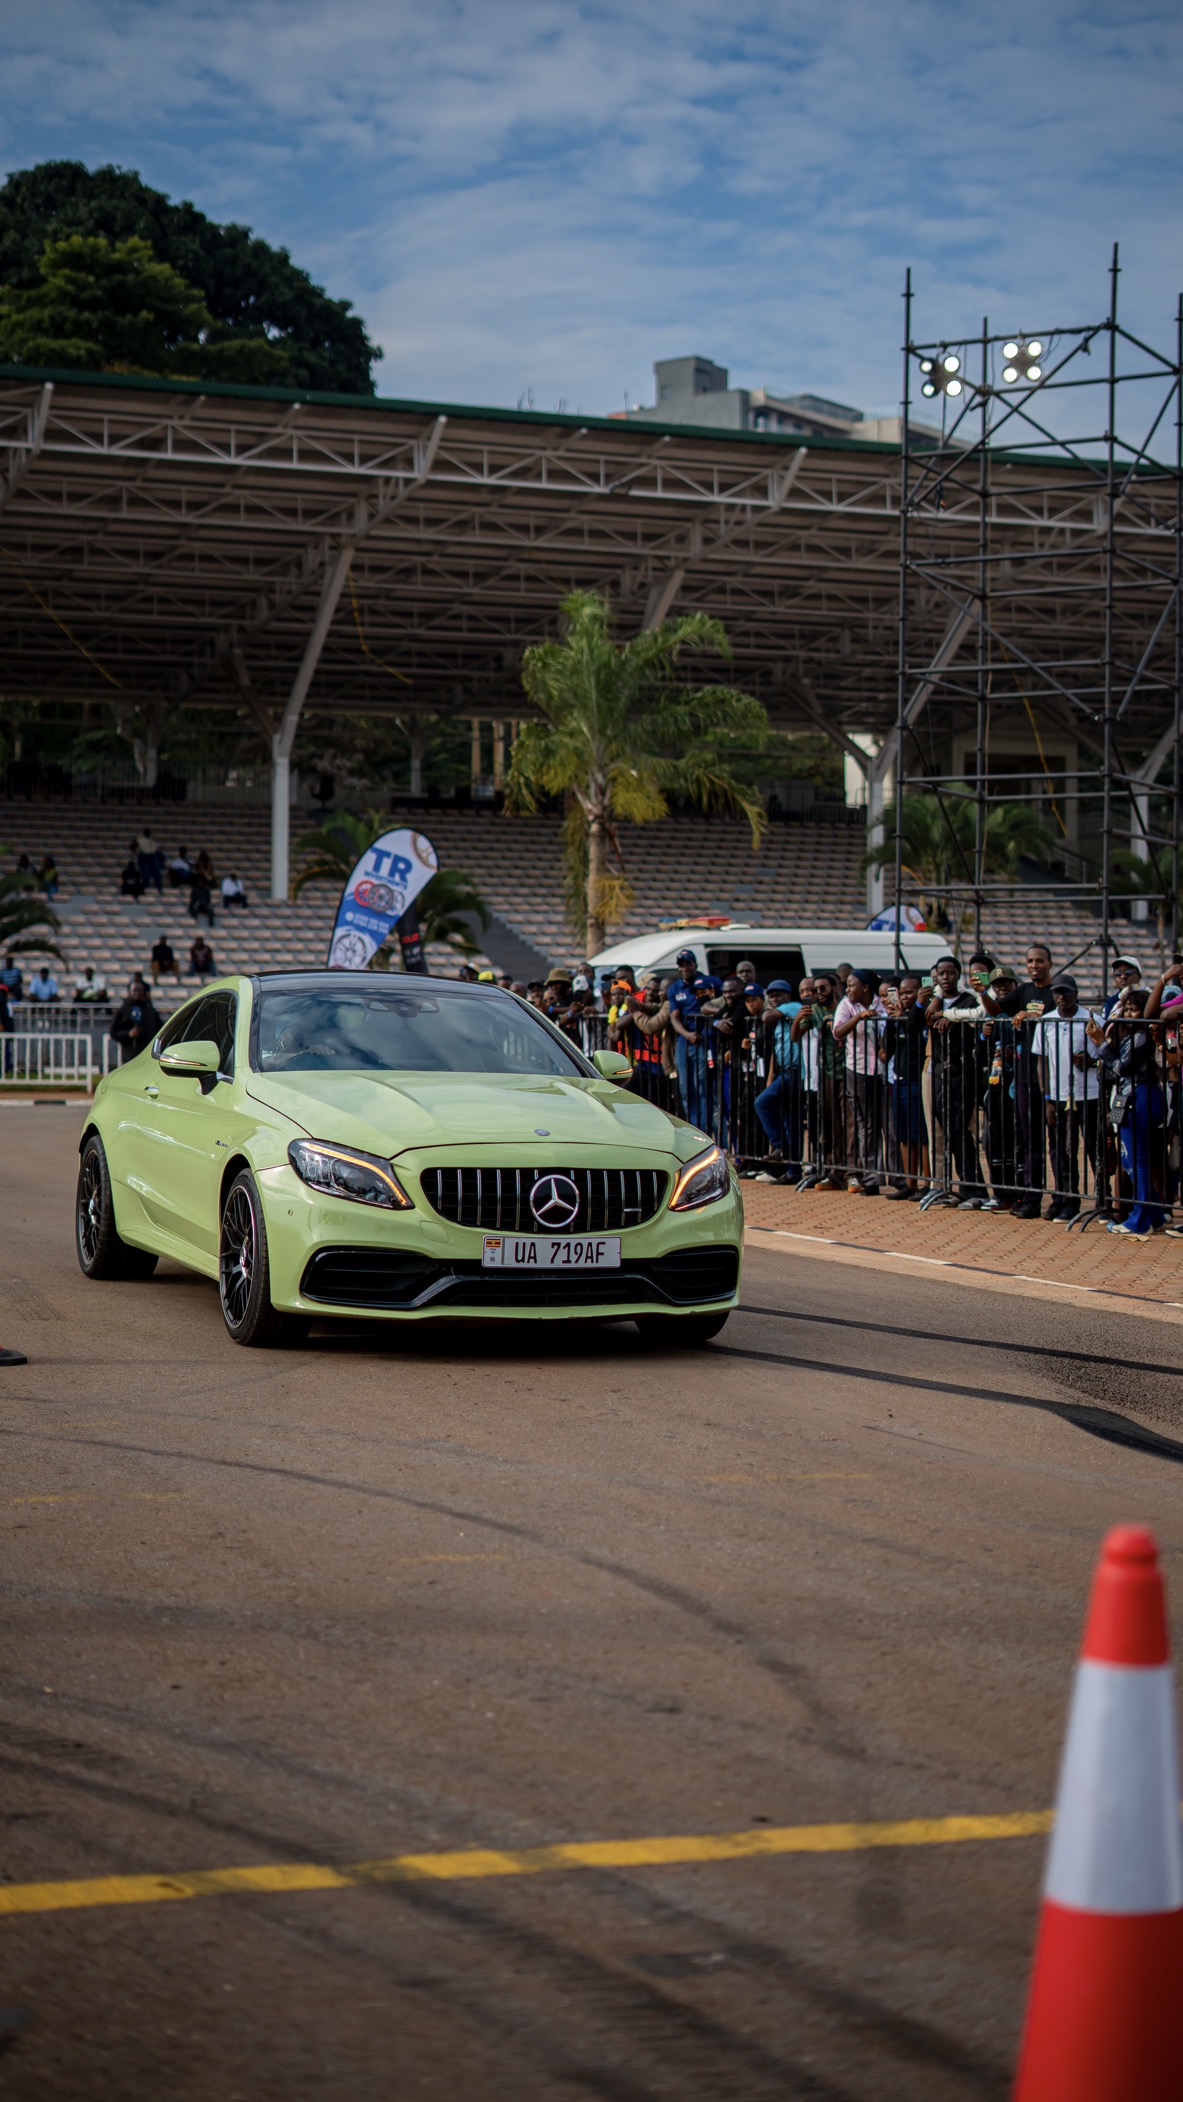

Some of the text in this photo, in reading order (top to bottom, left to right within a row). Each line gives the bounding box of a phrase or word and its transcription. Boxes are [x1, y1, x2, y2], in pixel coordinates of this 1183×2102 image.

[370, 847, 413, 883] TR
[871, 919, 906, 931] T
[514, 1241, 607, 1264] UA 719AF
